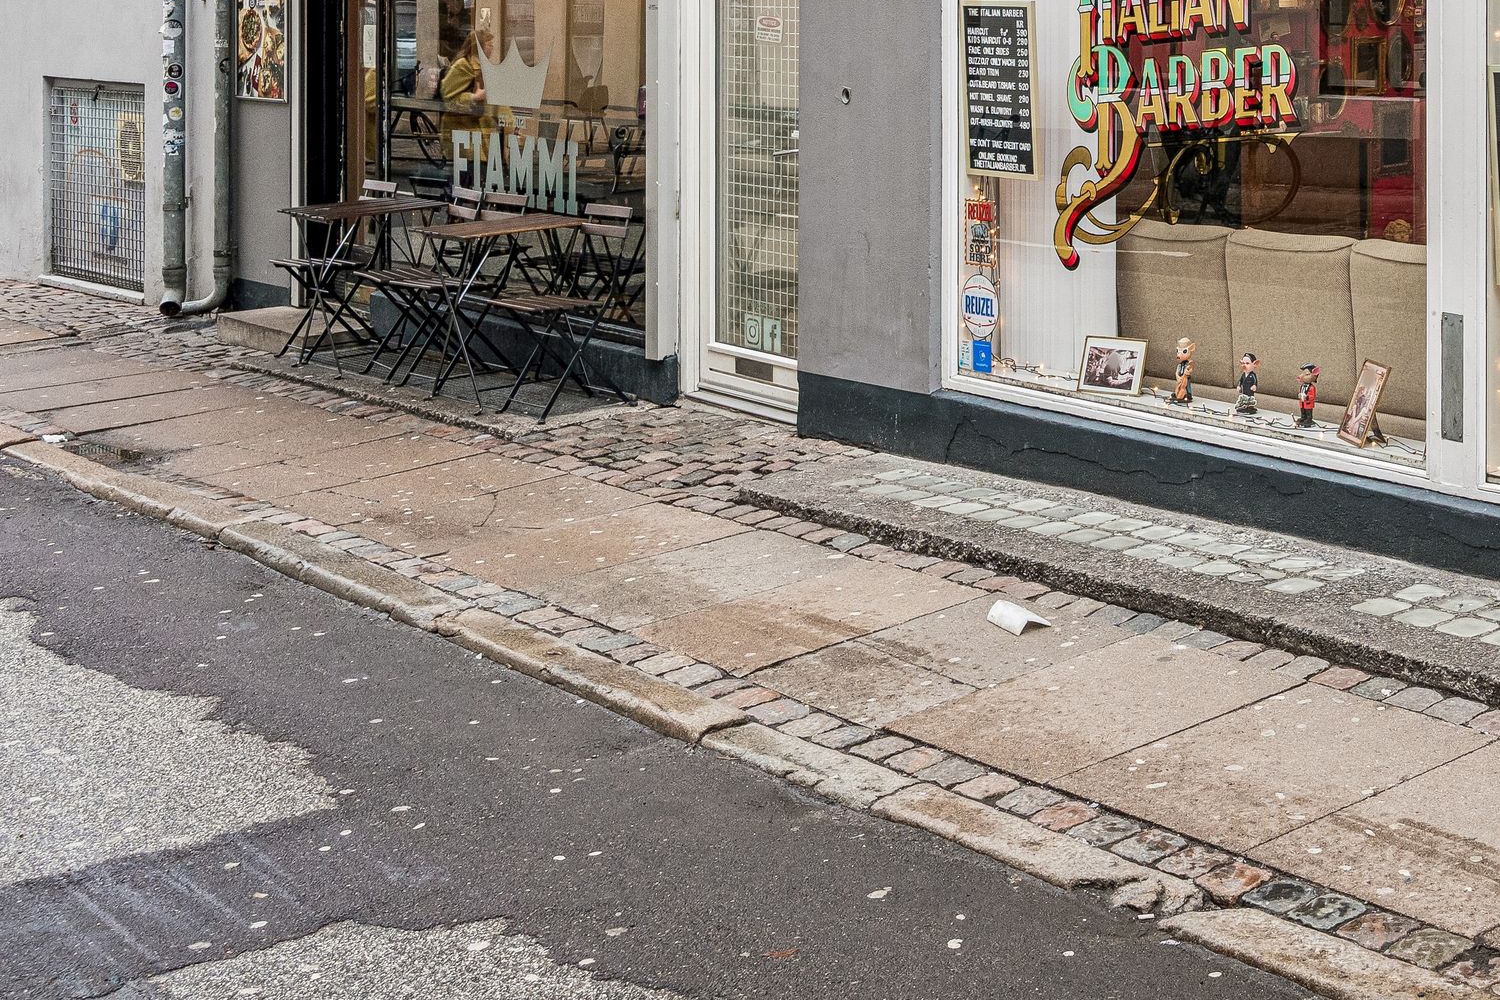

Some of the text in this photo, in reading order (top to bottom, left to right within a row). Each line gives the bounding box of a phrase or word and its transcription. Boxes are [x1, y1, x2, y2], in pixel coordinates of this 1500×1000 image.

[968, 8, 1024, 18] THE ITALIAN BARBER
[967, 27, 989, 36] HAIRCUT
[968, 36, 980, 44] KIDS
[981, 36, 1001, 45] HAIRCUT
[968, 46, 981, 54] FADE
[983, 47, 995, 55] ONLY
[995, 47, 1009, 56] SIDES
[1017, 59, 1028, 67] 200
[968, 67, 986, 76] BEARD
[987, 68, 1000, 76] TRIM
[1018, 82, 1029, 91] 520
[969, 92, 979, 100] HOT
[980, 93, 995, 101] TOWEL
[996, 94, 1012, 103] SHAVE
[970, 105, 984, 113] WASH
[1018, 108, 1030, 117] 420
[970, 138, 977, 147] WE
[992, 140, 1003, 149] TAKE
[1003, 141, 1019, 150] CREDIT
[1019, 142, 1031, 151] CARD
[978, 152, 1018, 163] ONLINE BOOKING
[452, 130, 578, 215] FIAMMI
[965, 295, 994, 317] REUZEL
